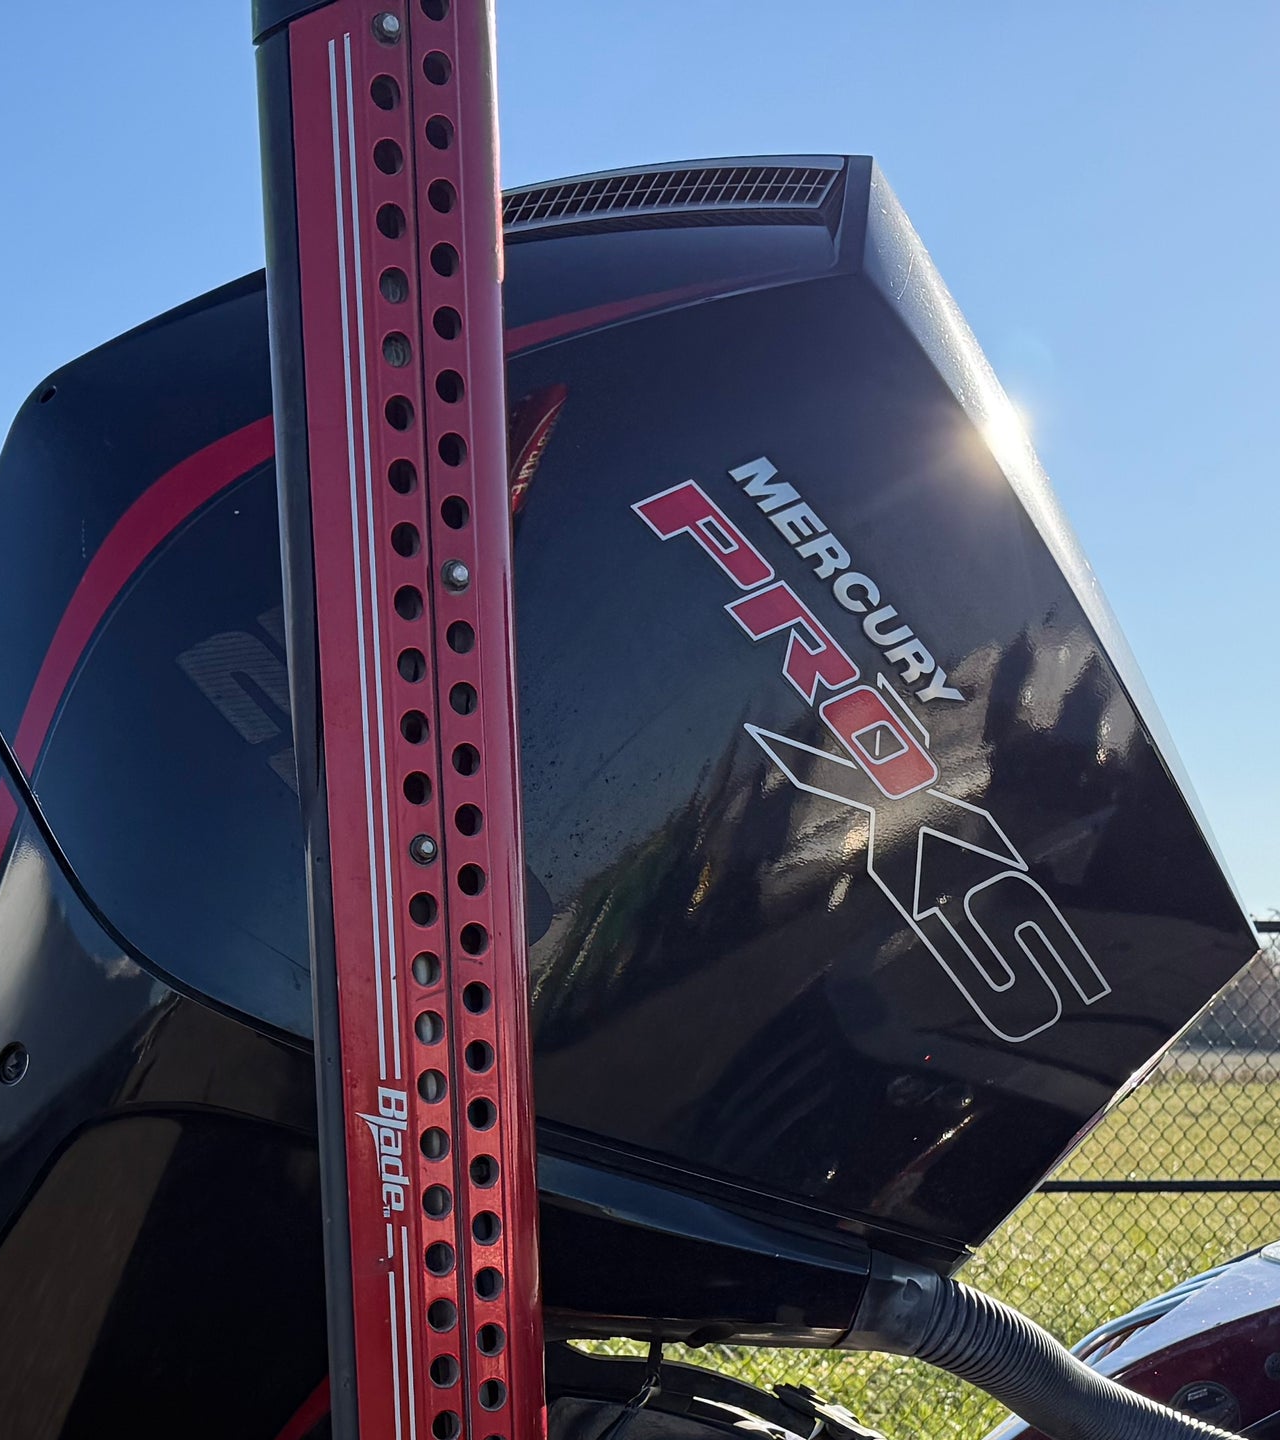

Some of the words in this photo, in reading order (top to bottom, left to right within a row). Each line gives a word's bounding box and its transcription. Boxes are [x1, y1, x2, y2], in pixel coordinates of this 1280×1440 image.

[630, 479, 939, 800] PRO
[727, 456, 965, 702] MERCURY
[744, 673, 1112, 1042] XS
[357, 1086, 410, 1212] Blade
